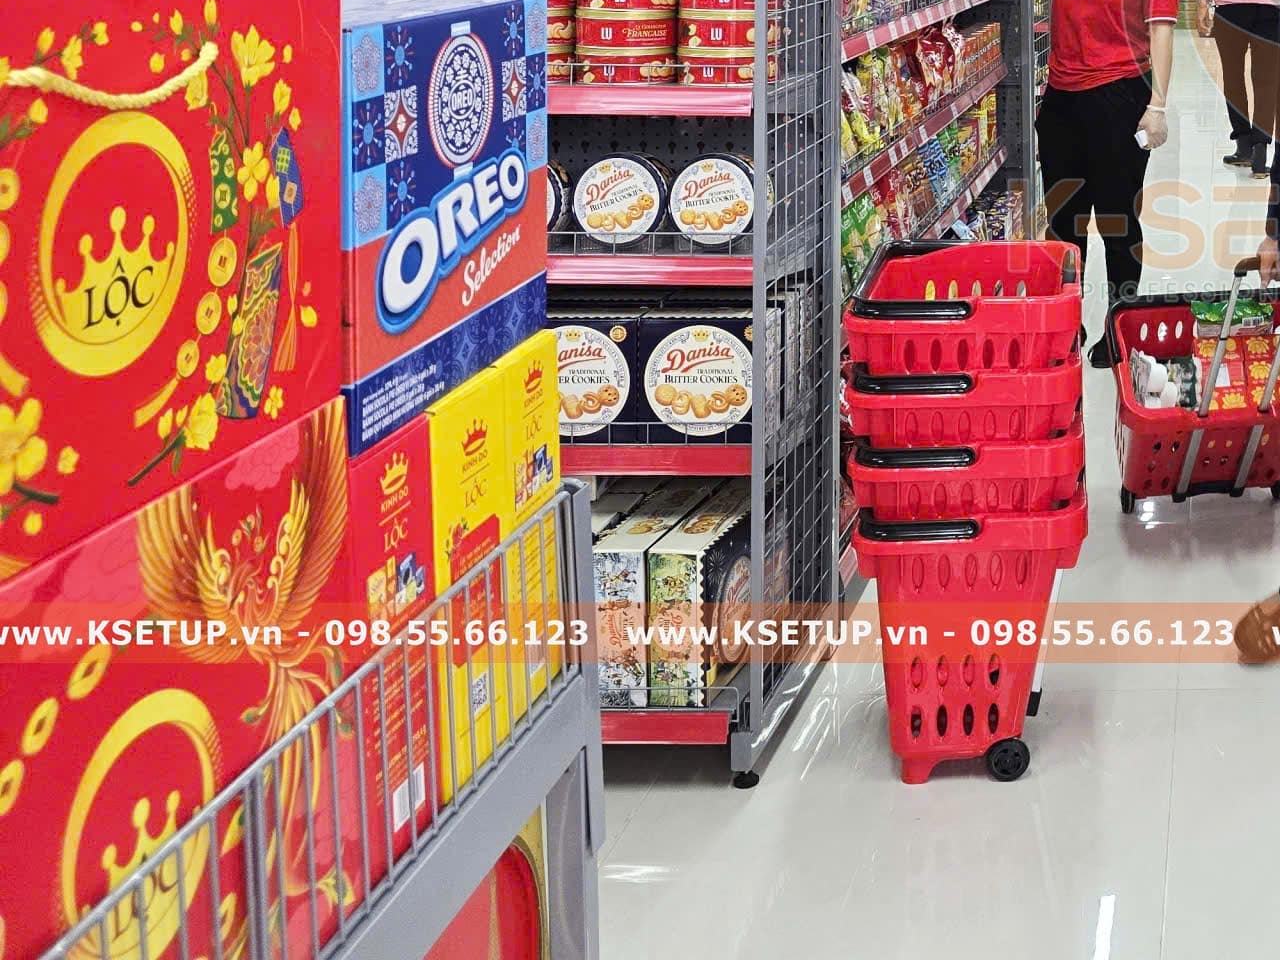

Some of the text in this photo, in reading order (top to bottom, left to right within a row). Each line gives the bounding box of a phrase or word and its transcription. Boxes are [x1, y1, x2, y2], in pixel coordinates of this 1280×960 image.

[601, 27, 613, 40] LU
[710, 27, 723, 41] LU
[452, 88, 473, 111] OREO
[586, 169, 634, 206] Danisa
[590, 187, 643, 212] BUTTER COOKIES
[681, 171, 734, 201] Danisa
[685, 193, 740, 208] BUTTER COOKIES
[382, 152, 527, 314] OREO
[462, 224, 522, 307] Selection
[82, 262, 155, 332] LỘC
[557, 343, 607, 370] anisa
[661, 342, 735, 374] Danisa
[571, 375, 610, 384] COOKIES
[664, 375, 738, 384] BUTTER COOKIES
[526, 413, 543, 441] LỘC
[380, 493, 399, 514] KINH
[464, 477, 487, 509] LỘC
[384, 517, 409, 553] LỘC
